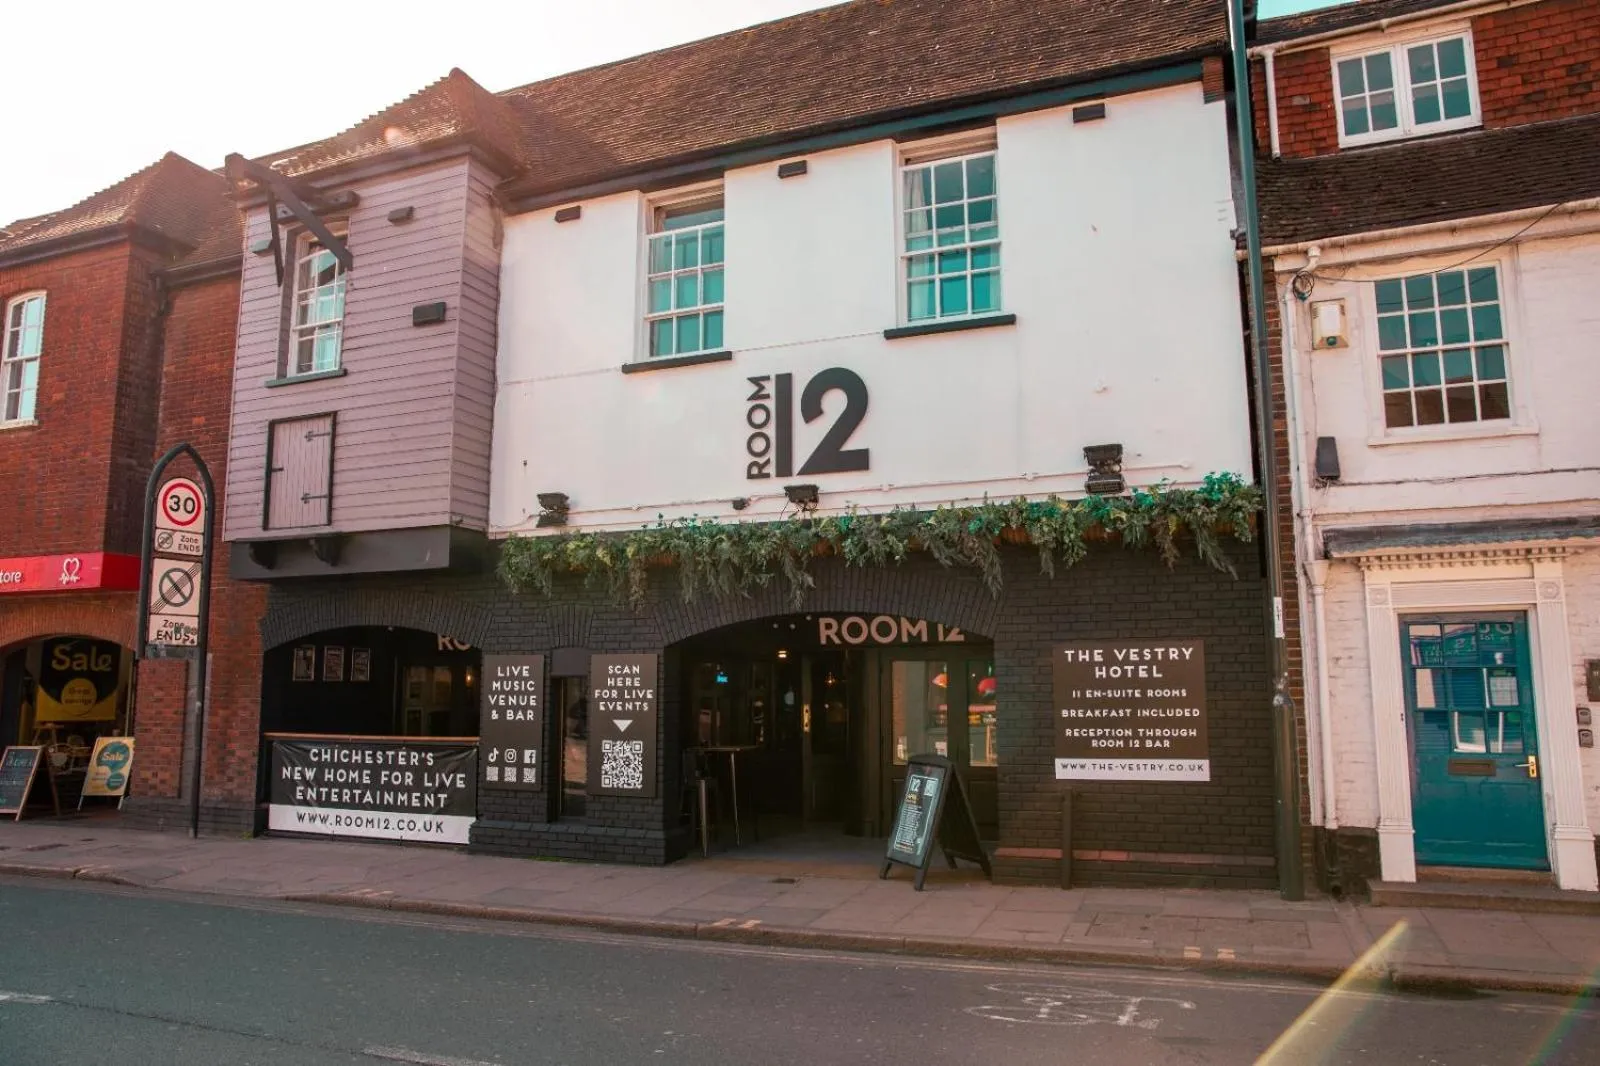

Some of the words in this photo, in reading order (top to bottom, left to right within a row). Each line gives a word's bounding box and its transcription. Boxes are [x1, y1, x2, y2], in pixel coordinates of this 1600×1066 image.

[747, 375, 770, 479] ROOM
[775, 367, 869, 477] 12
[168, 494, 196, 514] 30
[180, 534, 199, 544] Zone
[178, 543, 201, 553] ENDS
[157, 630, 190, 641] ENDS
[818, 615, 928, 645] ROOM
[51, 644, 113, 672] Sale
[1064, 649, 1104, 662] THE
[1114, 647, 1193, 661] VESTRY
[497, 665, 530, 677] LIVE
[608, 665, 640, 675] SCAN
[1095, 665, 1163, 678] HOTEL
[492, 680, 535, 692] MUSIC
[607, 677, 641, 687] HERE
[594, 689, 618, 699] FOR
[624, 689, 654, 699] LIVE
[1086, 689, 1142, 698] EN-SUITE
[1147, 688, 1187, 697] ROOMS
[488, 694, 537, 706] VENUE
[599, 701, 649, 711] EVENTS
[491, 710, 499, 720] &
[506, 710, 535, 721] BAR
[1061, 708, 1132, 718] BREAKFAST
[1137, 708, 1200, 717] INCLUDED
[1065, 728, 1133, 737] RECEPTION
[1137, 728, 1197, 737] THROUGH
[1091, 739, 1124, 748] ROOM
[1129, 739, 1140, 748] 12
[1145, 739, 1170, 748] BAR
[309, 748, 434, 766] CHICHESTER'S
[1060, 763, 1204, 772] WWW.THE-VESTRY.CO.UK
[282, 766, 317, 781] NEW
[324, 768, 371, 784] HOME
[381, 771, 414, 786] FOR
[424, 773, 466, 788] LIVE
[296, 786, 448, 808] ENTERTAINMENT
[296, 811, 444, 833] WWW.ROOM12.CO.UK
